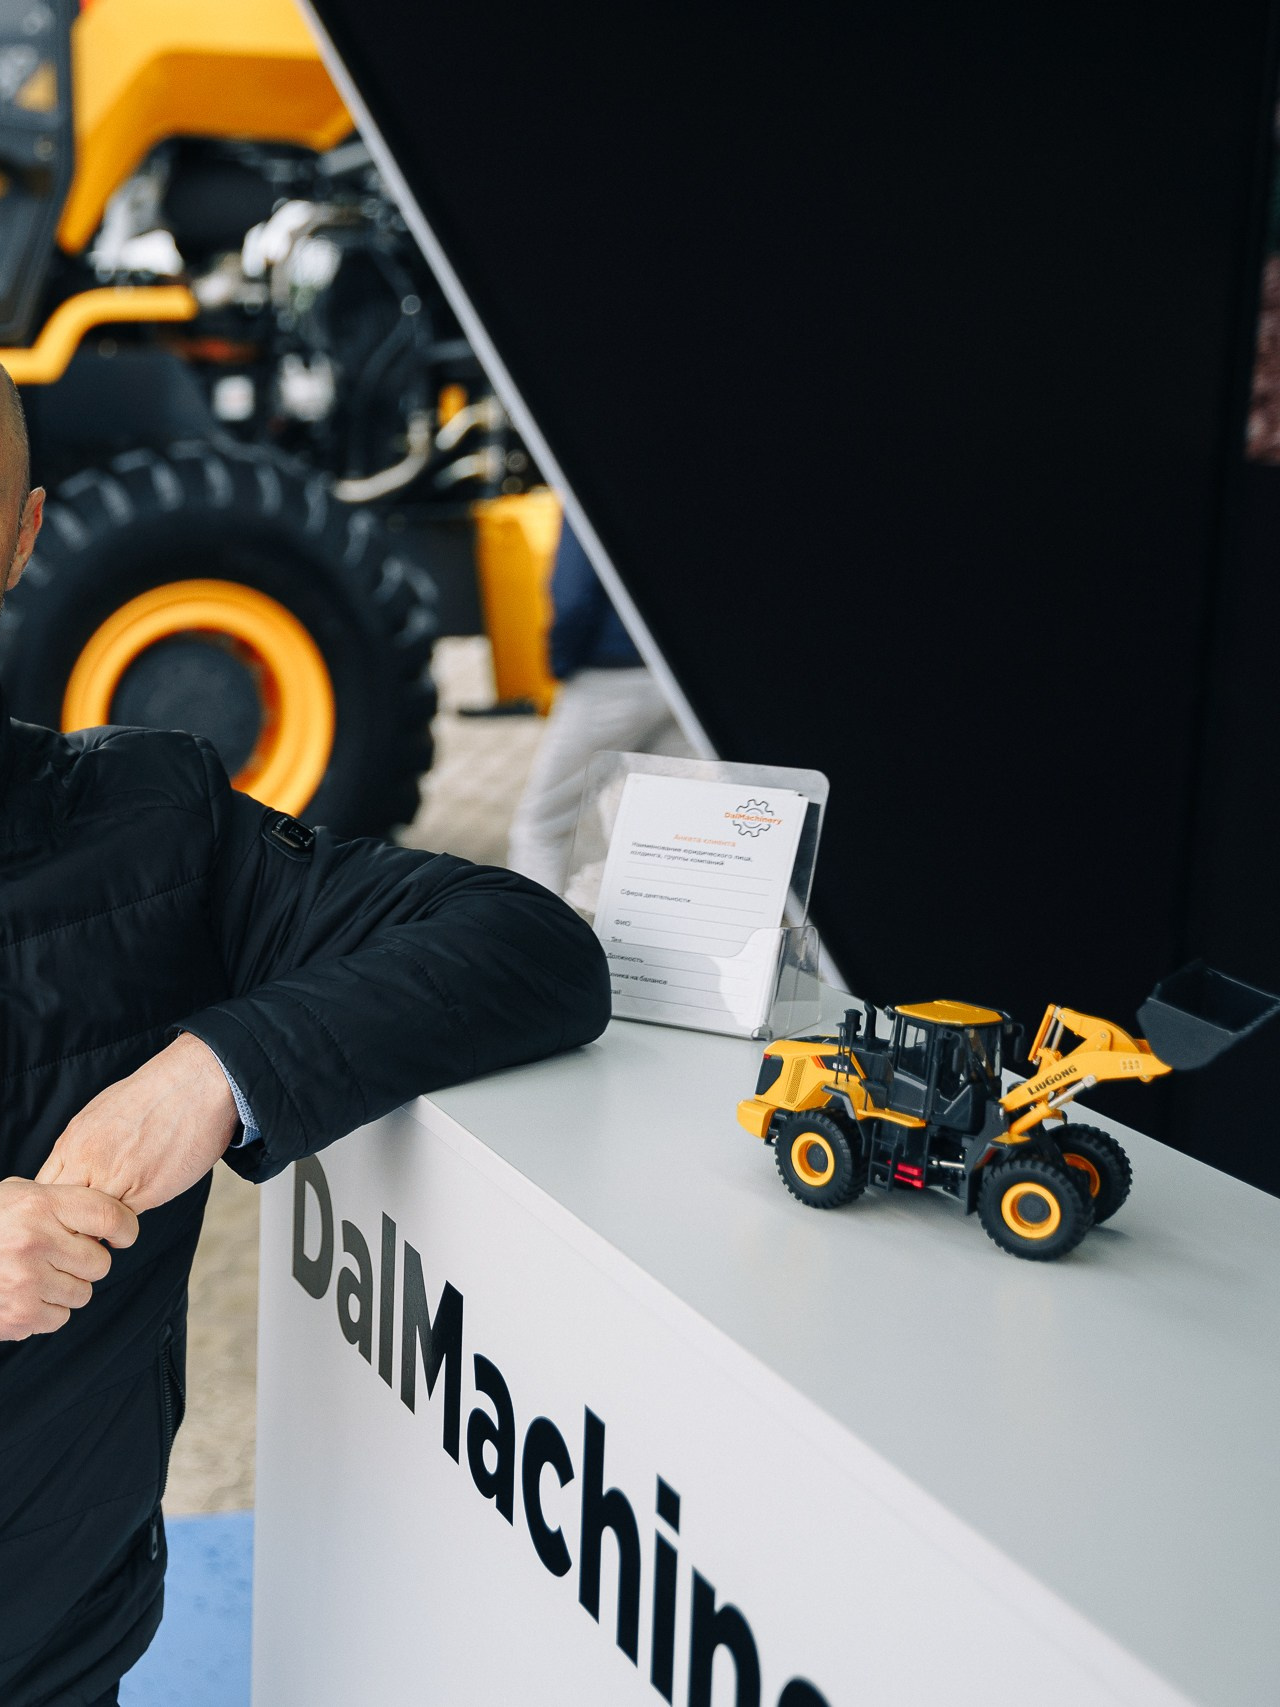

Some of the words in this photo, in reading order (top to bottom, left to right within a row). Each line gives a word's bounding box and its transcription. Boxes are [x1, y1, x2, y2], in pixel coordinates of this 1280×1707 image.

[724, 811, 783, 825] DalMachinery
[620, 888, 643, 898] Сфера
[292, 1152, 834, 1707] DalMachin
